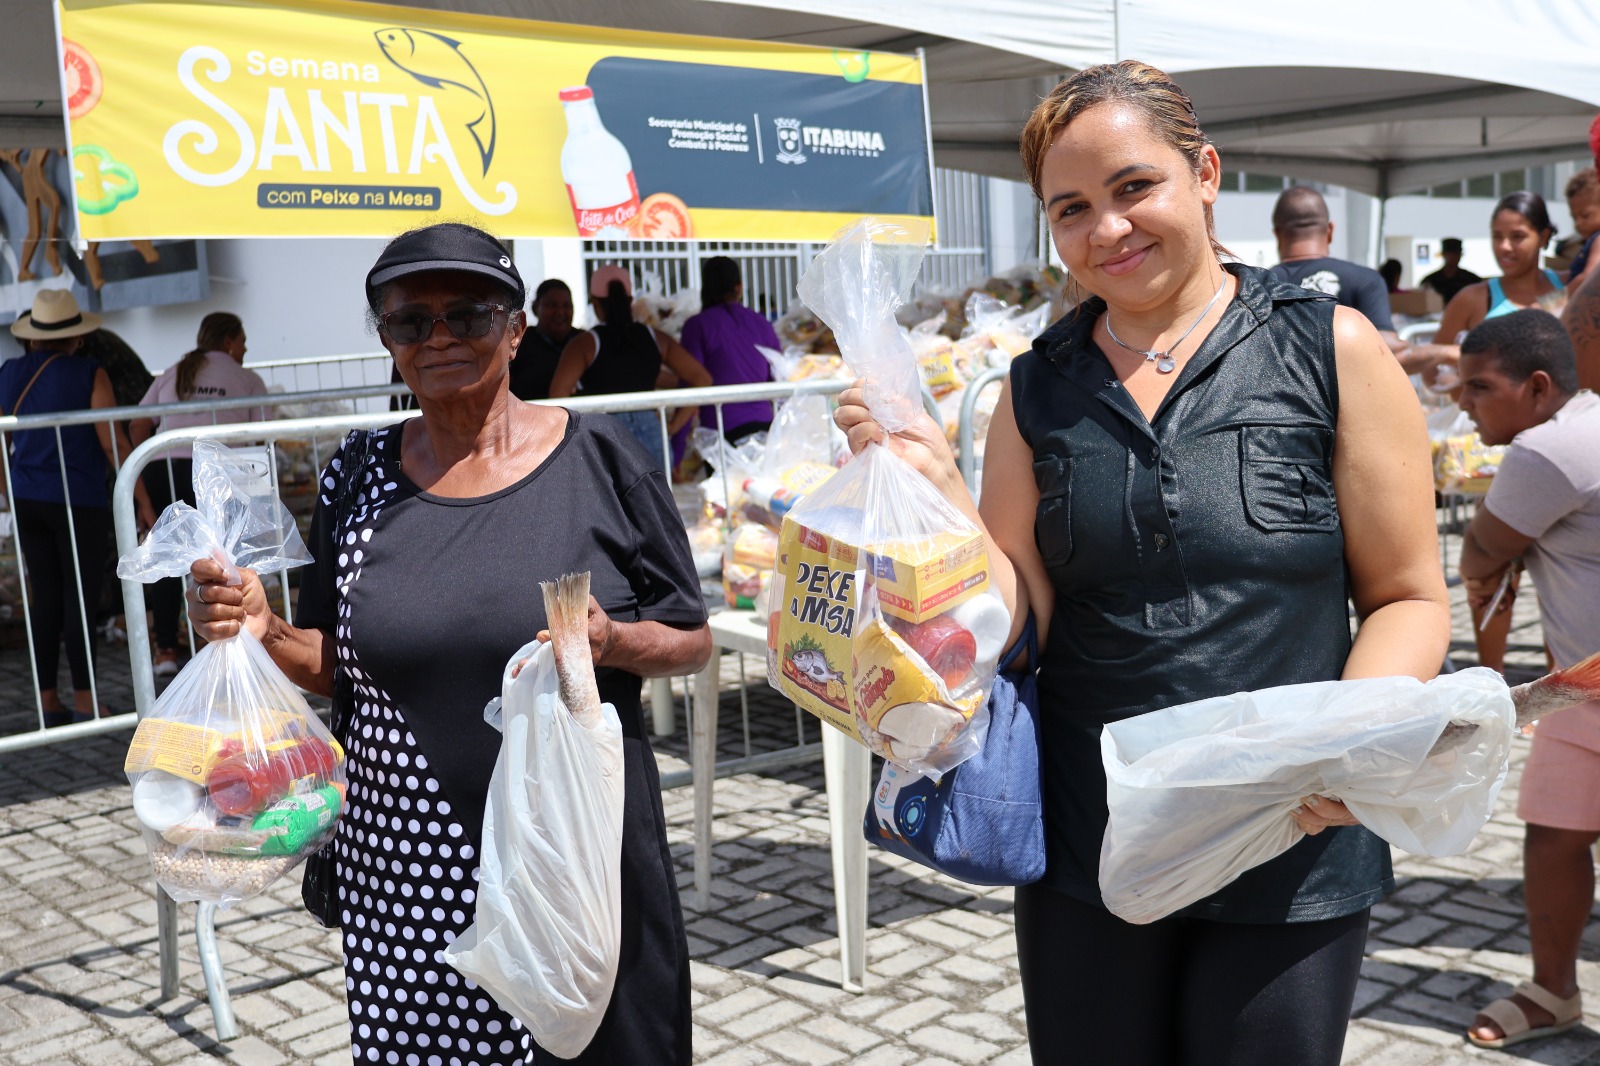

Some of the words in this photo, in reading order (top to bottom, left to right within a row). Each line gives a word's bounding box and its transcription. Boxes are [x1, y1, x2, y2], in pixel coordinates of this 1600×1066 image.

[247, 50, 380, 83] Semana
[163, 45, 518, 216] SANTA
[648, 116, 693, 129] Secretaria
[693, 119, 734, 132] Municipal
[735, 123, 747, 133] de
[672, 128, 715, 142] Promoção
[715, 131, 740, 142] Social
[803, 126, 886, 152] ITABUNA
[668, 138, 707, 150] Combate
[708, 140, 715, 150] à
[715, 141, 749, 152] Pobreza
[812, 146, 879, 158] PREFEITURA
[267, 190, 306, 205] com
[311, 188, 360, 205] Peixe
[364, 191, 385, 206] na
[389, 189, 434, 207] Mesa
[578, 210, 604, 231] Leite
[615, 205, 637, 225] Coco
